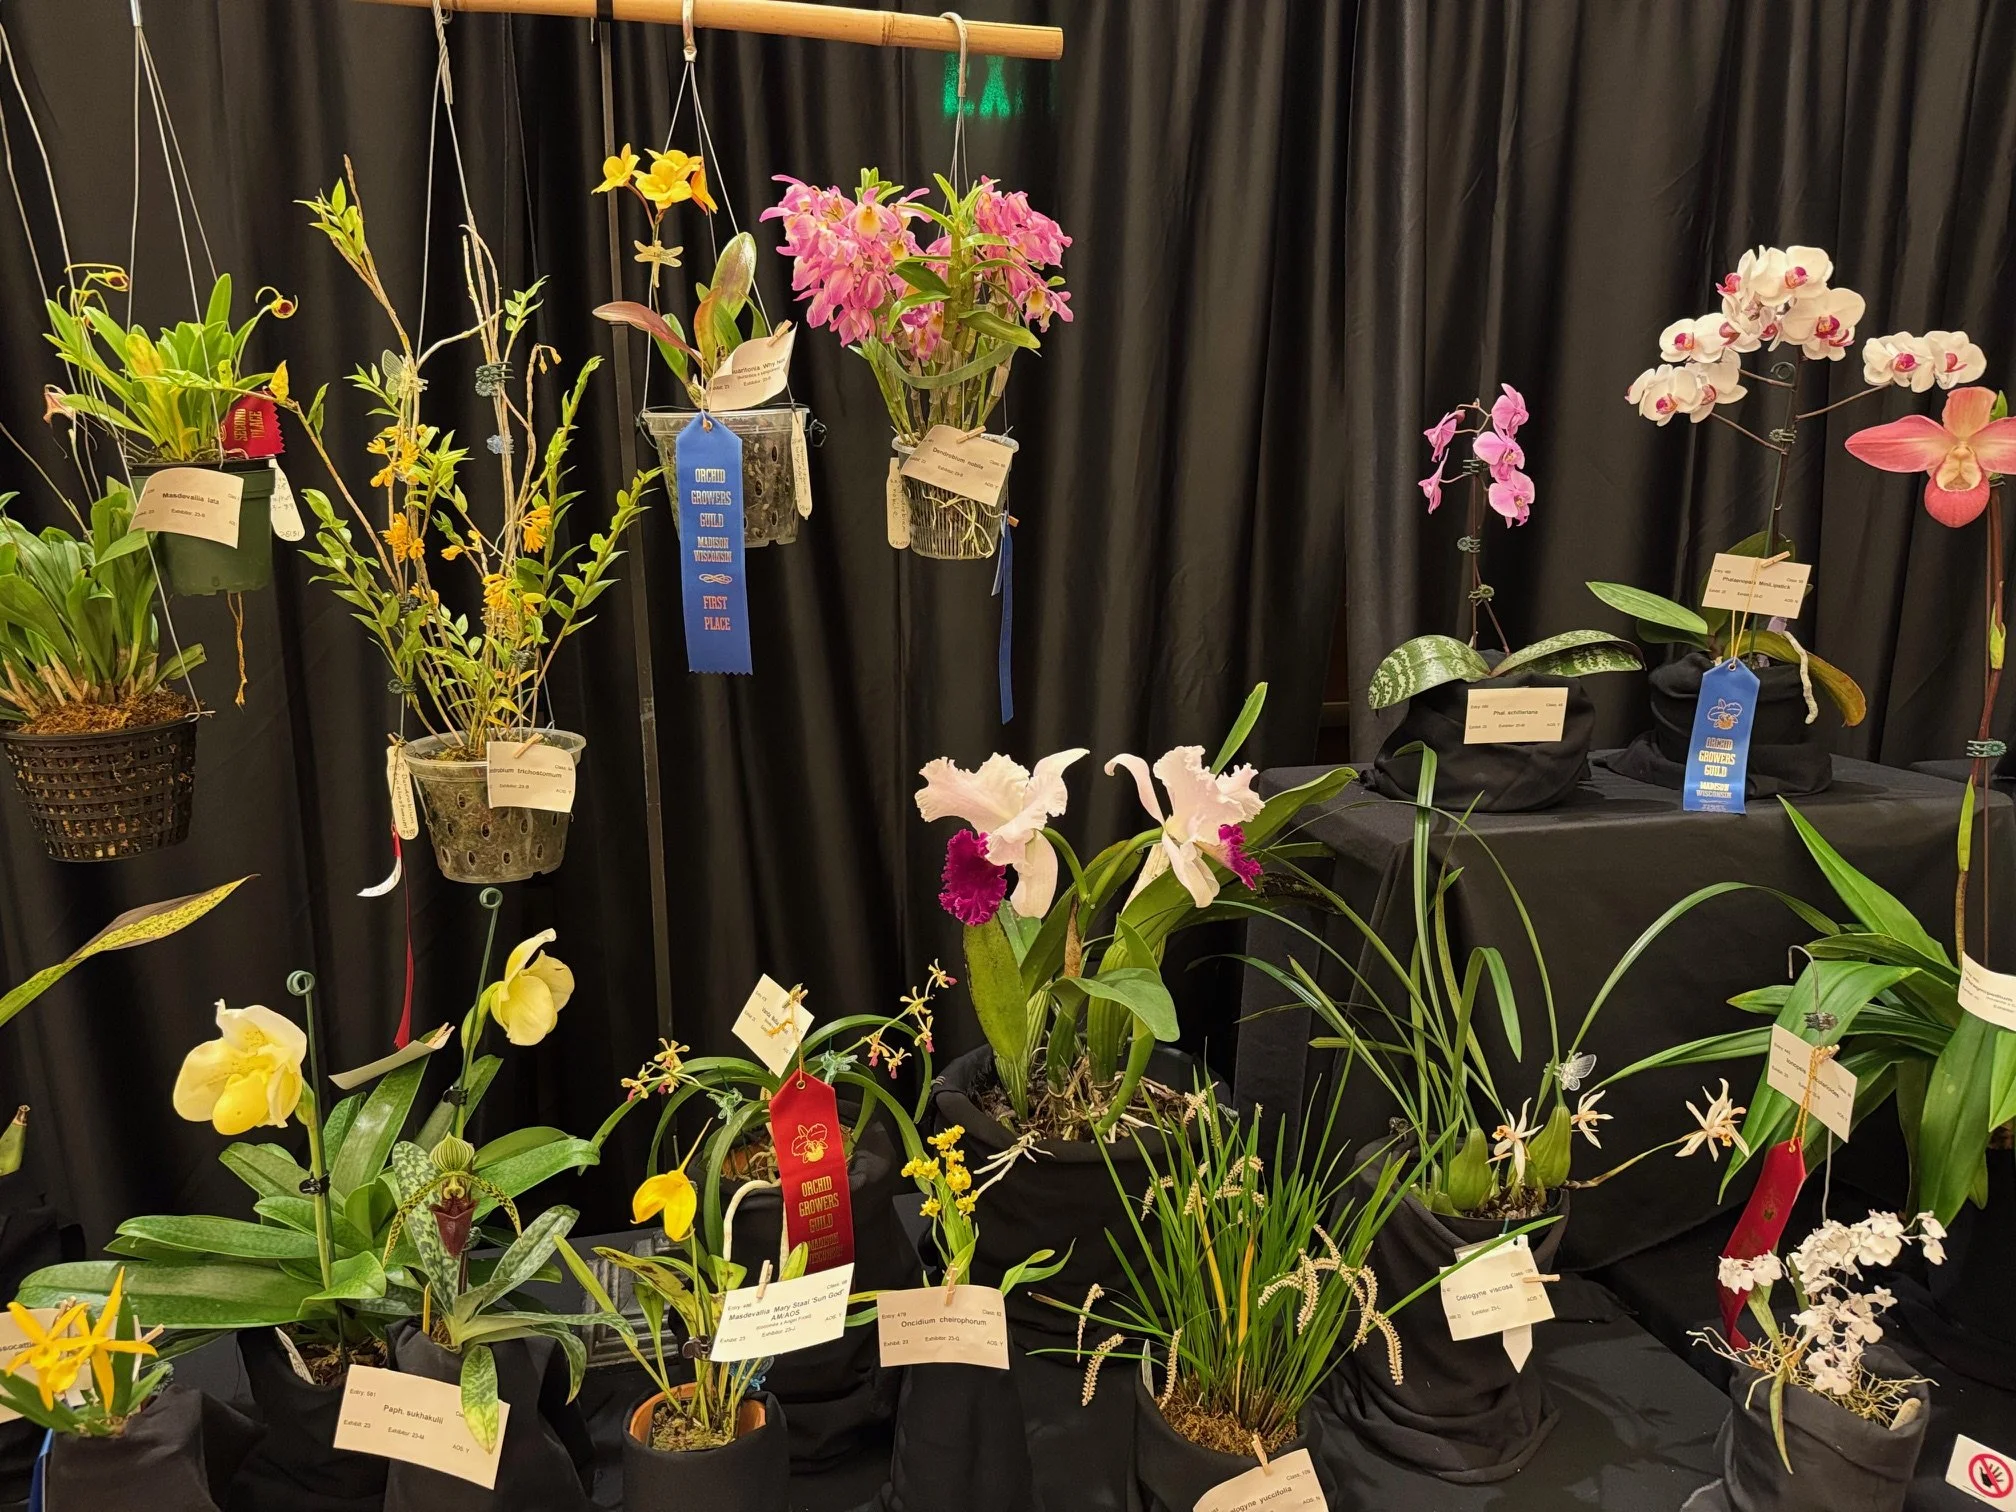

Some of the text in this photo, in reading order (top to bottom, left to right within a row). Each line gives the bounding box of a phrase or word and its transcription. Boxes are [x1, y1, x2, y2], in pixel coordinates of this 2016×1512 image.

[233, 408, 248, 442] SECOND
[932, 446, 984, 470] Dendrobium nobile
[695, 468, 726, 484] ORCHID
[162, 491, 205, 503] Masdevallia
[691, 490, 732, 506] GROWERS
[699, 512, 724, 528] GUILD
[697, 536, 729, 549] MADISON
[693, 550, 733, 563] WISCONSIN
[702, 595, 728, 610] FIRST
[703, 616, 731, 631] PLACE
[1705, 737, 1733, 750] ORCHID
[1698, 750, 1736, 765] GROWERS
[1704, 764, 1728, 777] GUILD
[1696, 790, 1732, 798] WISCONSIN
[1700, 781, 1730, 791] MADISON
[801, 1176, 833, 1197] ORCHID
[798, 1192, 840, 1217] GROWERS
[809, 1213, 833, 1233] GUILD
[1456, 1289, 1487, 1301] Coelogyne
[1489, 1284, 1514, 1293] viscosa
[729, 1309, 770, 1320] Masdevallia
[773, 1305, 791, 1313] Mary
[792, 1300, 810, 1309] Staal
[812, 1295, 827, 1304] 'Sun
[901, 1316, 986, 1328] Oncidium cheirophorum
[384, 1404, 444, 1424] Paph. sukhakulii
[1260, 1486, 1292, 1504] yuccifolia
